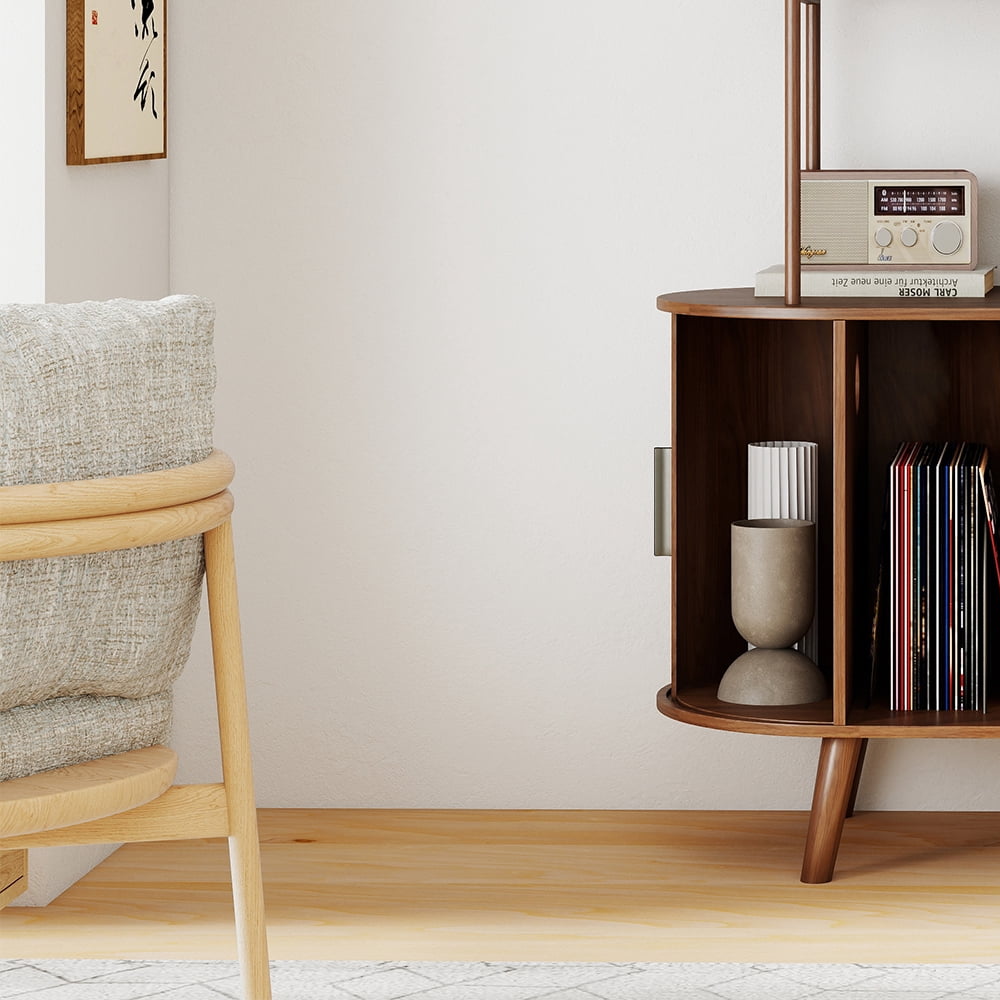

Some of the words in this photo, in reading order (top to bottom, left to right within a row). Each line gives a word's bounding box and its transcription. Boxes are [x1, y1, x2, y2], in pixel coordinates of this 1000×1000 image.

[831, 278, 849, 288] Zeit
[850, 278, 872, 288] neue
[873, 278, 893, 288] eine
[894, 278, 908, 288] für
[910, 278, 959, 288] Architektur
[898, 288, 931, 297] MOSER
[934, 288, 958, 297] CARL
